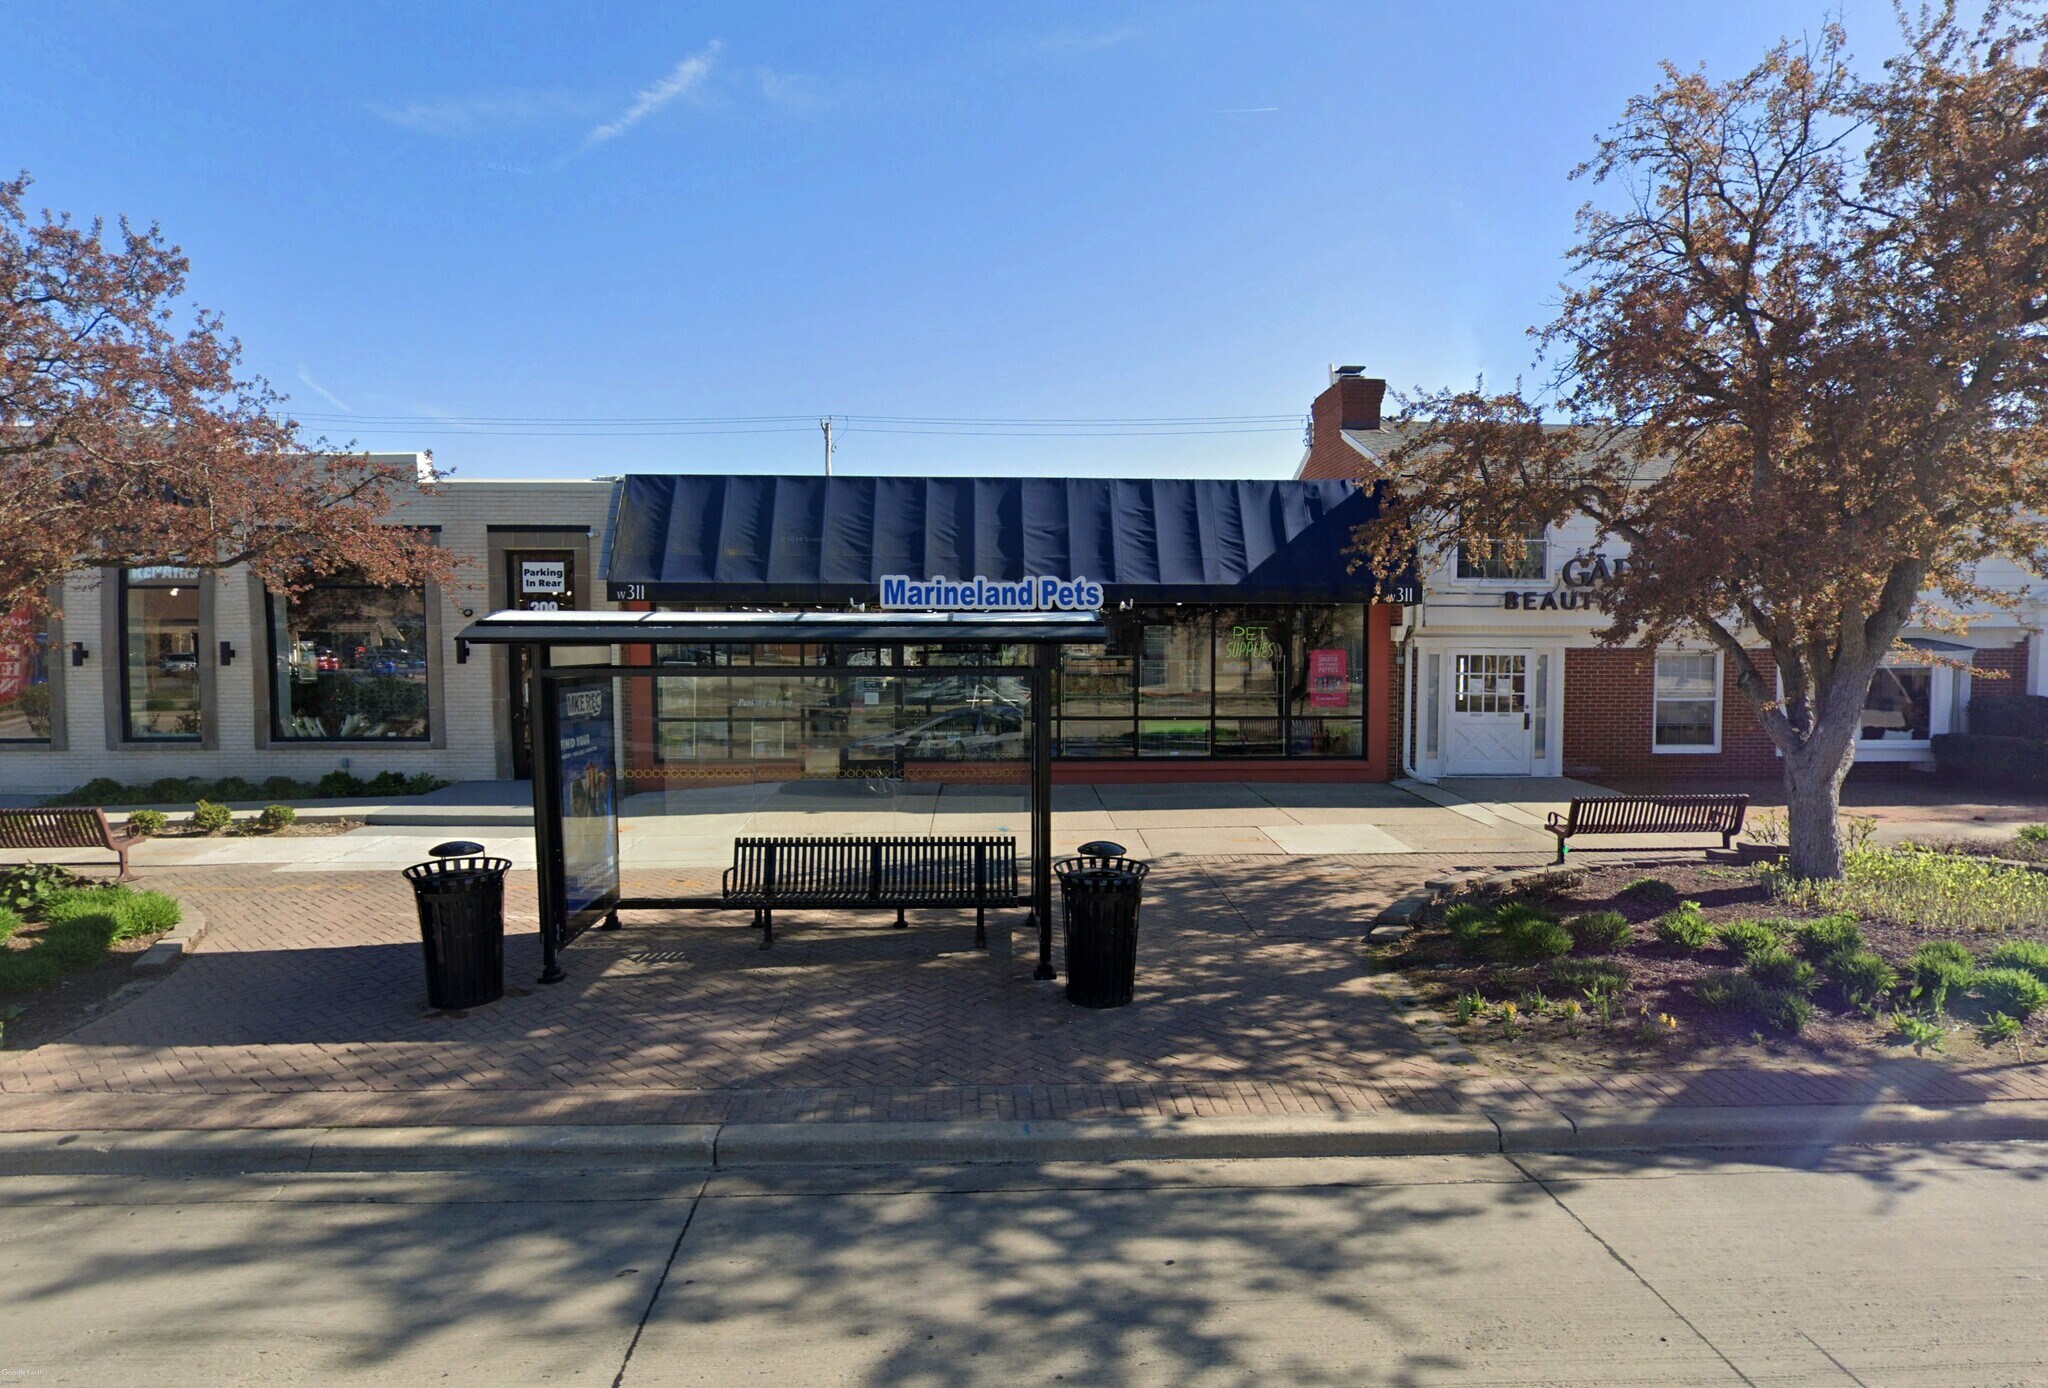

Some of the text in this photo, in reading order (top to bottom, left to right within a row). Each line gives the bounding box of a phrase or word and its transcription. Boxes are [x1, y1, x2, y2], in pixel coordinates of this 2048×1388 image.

[524, 567, 564, 578] Parking
[525, 579, 563, 588] In Rear
[883, 579, 1101, 606] Marineland Pets
[1233, 626, 1269, 641] PET
[1225, 641, 1275, 659] SUPPLIES
